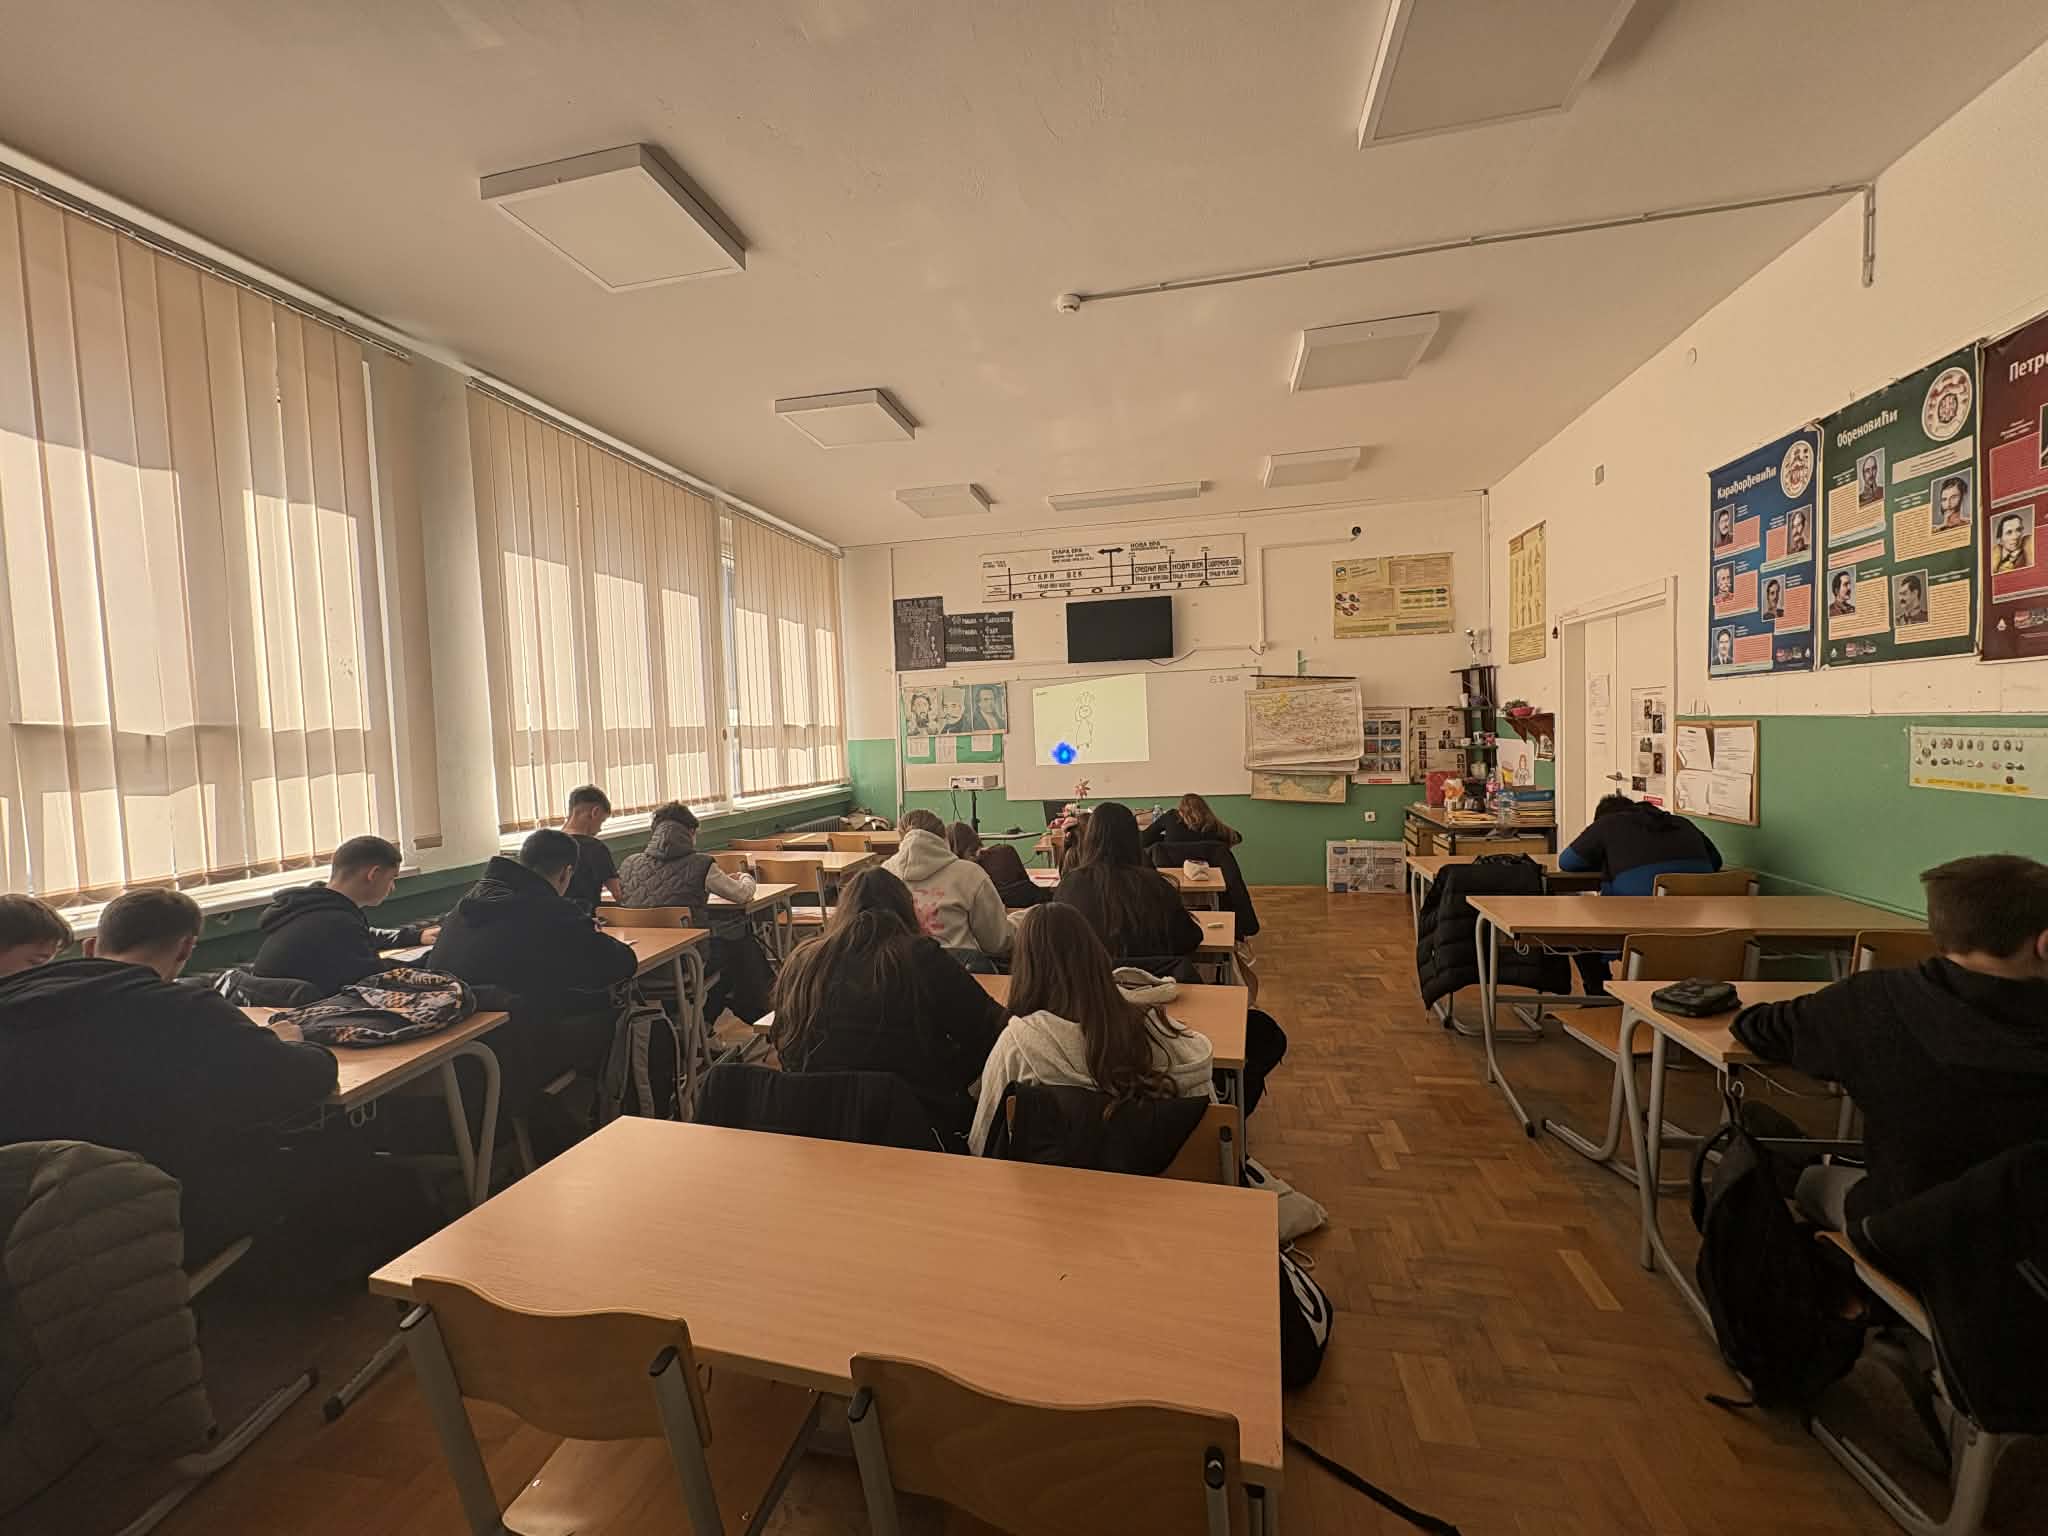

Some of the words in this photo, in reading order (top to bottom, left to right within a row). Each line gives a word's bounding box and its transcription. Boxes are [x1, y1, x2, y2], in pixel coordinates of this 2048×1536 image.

[1836, 409, 1899, 448] Обреновићи
[1717, 466, 1778, 499] Карађорђевићи
[1027, 573, 1055, 581] СТАРИ
